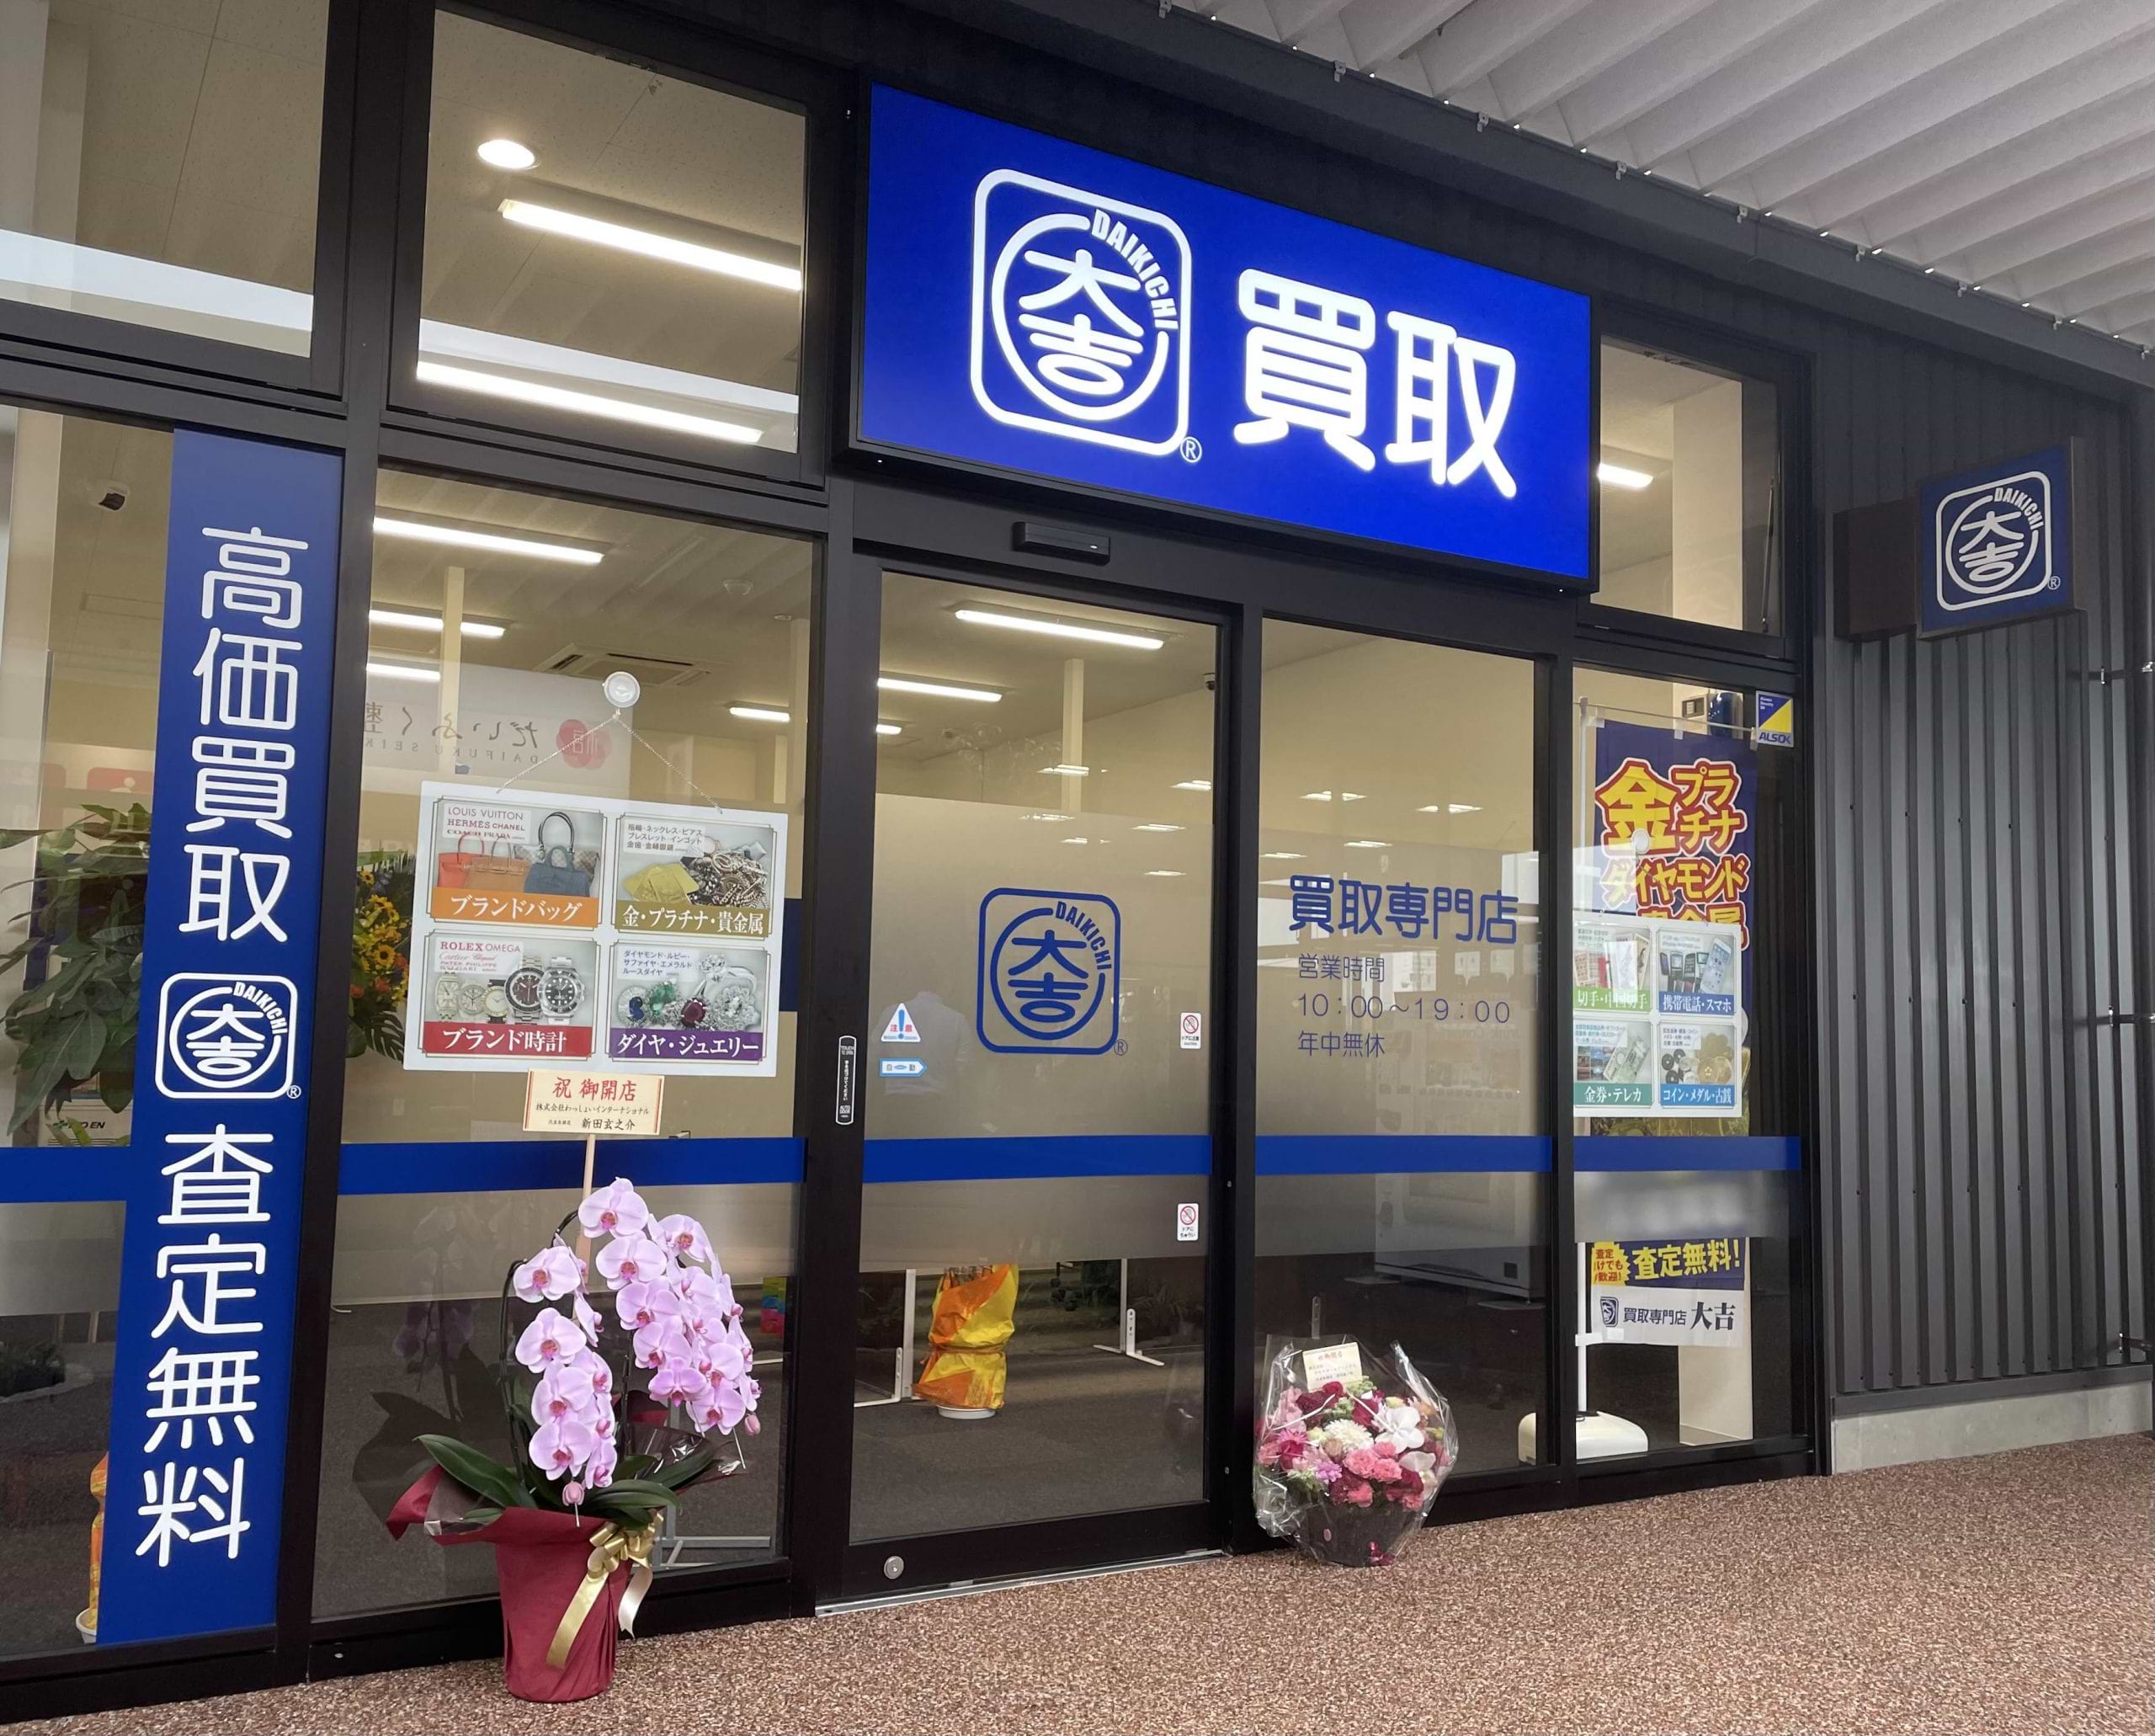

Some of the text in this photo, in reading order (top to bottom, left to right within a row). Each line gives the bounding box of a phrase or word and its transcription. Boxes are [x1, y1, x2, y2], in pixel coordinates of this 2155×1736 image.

[1091, 208, 1179, 330] DAIKICHI
[1233, 268, 1517, 498] 買取
[1993, 487, 2045, 530] DAIKICHI
[178, 526, 309, 943] 高価買取
[1759, 732, 1791, 744] ALSOK
[448, 807, 524, 821] LOUIS VUITTON
[1597, 761, 1680, 853] 金
[492, 823, 525, 832] CHANEL
[1601, 856, 1748, 906] ダイヤモンド
[450, 894, 583, 923] ブランドバッグ
[621, 904, 764, 935] 金・プラチナ・貴金属
[1289, 875, 1519, 944] 買取専門店
[439, 941, 521, 953] ROLEX OMEGA
[1055, 901, 1112, 970] DAIKICHI
[1298, 953, 1385, 982] 営業時間
[232, 981, 289, 1035] DAIKICHI
[1663, 994, 1732, 1014] 携帯電話・スマホ
[443, 1026, 567, 1053] ブランド時計
[618, 1033, 759, 1057] ダイヤ・ジュエリー
[1297, 1030, 1386, 1058] 年中無休
[552, 1076, 637, 1102] 祝 御開店
[1594, 1259, 1624, 1271] けでも
[1631, 1238, 1742, 1281] 査定無料!
[1594, 1270, 1622, 1282] 歓迎!
[1623, 1307, 1687, 1326] 買取専門店
[1690, 1301, 1737, 1331] 大吉
[136, 1123, 274, 1568] 査定無料
